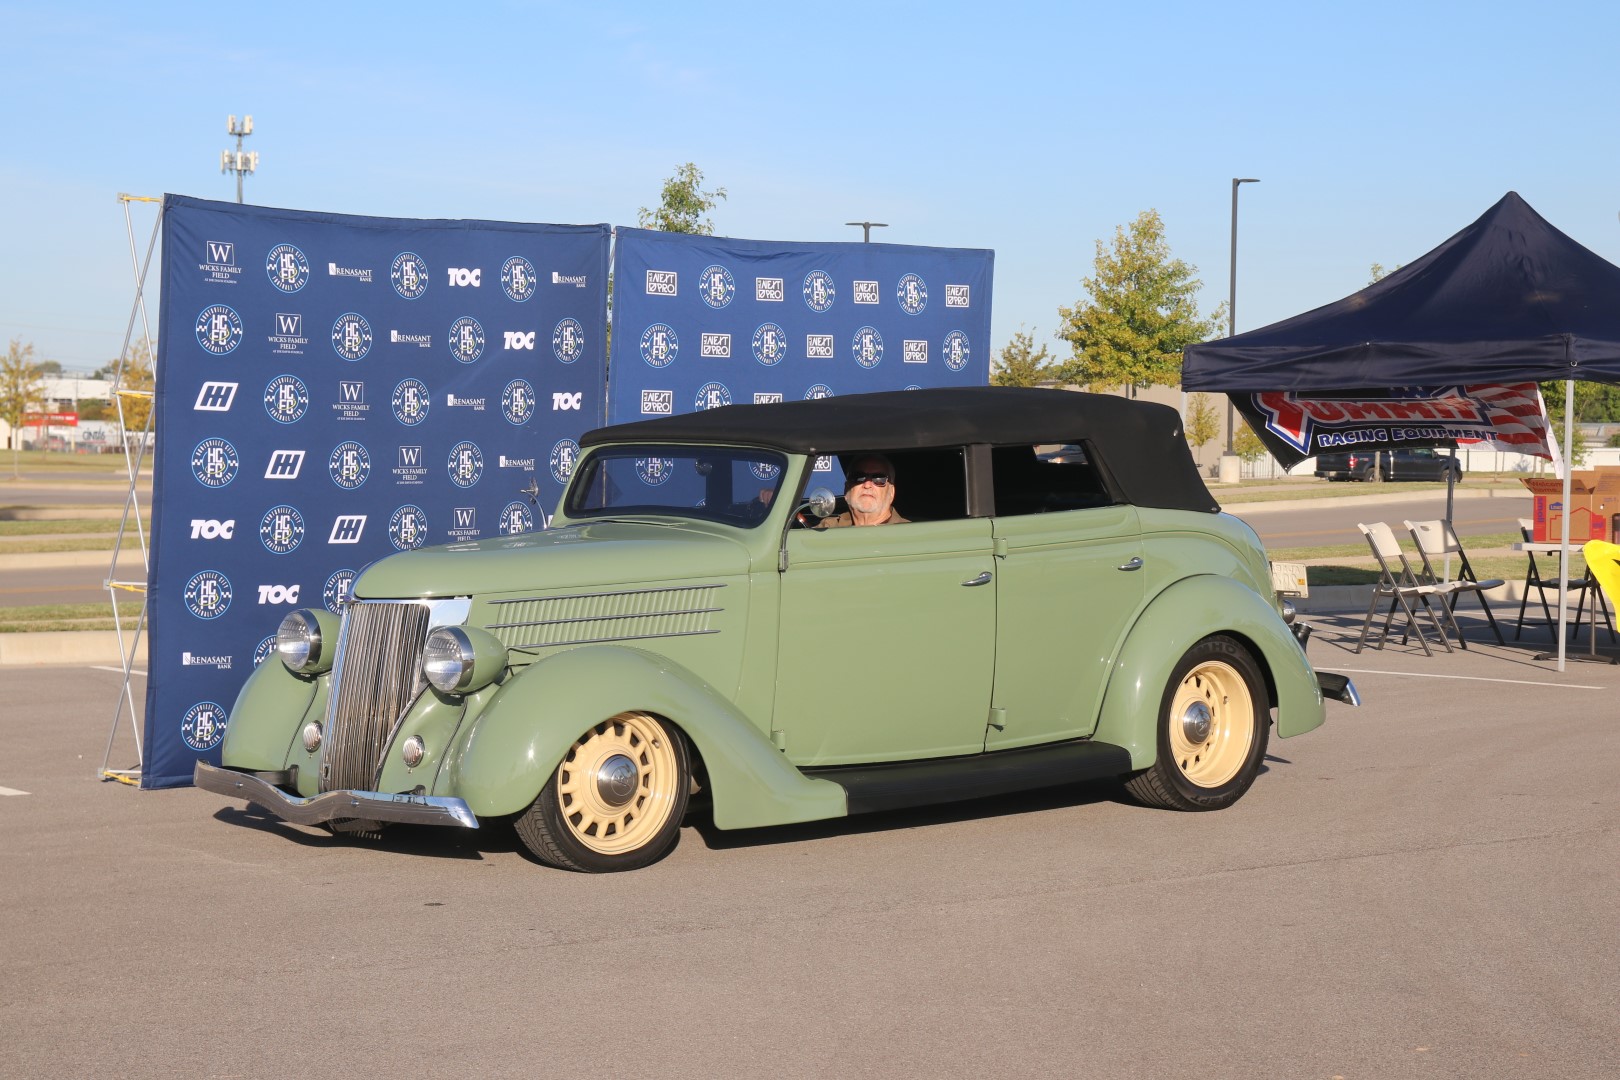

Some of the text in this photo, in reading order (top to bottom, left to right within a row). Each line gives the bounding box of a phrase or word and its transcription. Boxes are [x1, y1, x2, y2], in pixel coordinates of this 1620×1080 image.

[209, 243, 231, 264] W
[199, 264, 242, 275] WICKS FAMILY
[212, 271, 230, 279] FIELD
[448, 268, 480, 287] TOC
[653, 274, 675, 283] NEXT
[658, 284, 675, 293] PRO
[760, 281, 781, 289] NEXT
[859, 283, 876, 292] NEXT
[765, 290, 781, 299] PRO
[951, 288, 967, 296] NEXT
[862, 293, 877, 302] PRO
[953, 297, 967, 305] PRO
[287, 337, 308, 345] FAMILY
[504, 332, 535, 350] TOC
[708, 336, 728, 345] NEXT
[812, 337, 831, 346] NEXT
[712, 346, 728, 354] PRO
[815, 346, 831, 356] PRO
[909, 343, 925, 352] NEXT
[911, 352, 925, 361] PRO
[553, 392, 582, 410] TOC
[649, 393, 670, 402] NEXT
[653, 402, 670, 411] PRO
[1319, 426, 1498, 447] RACING EQUIPMENT
[191, 520, 235, 539] TOC
[258, 585, 300, 604] TOC
